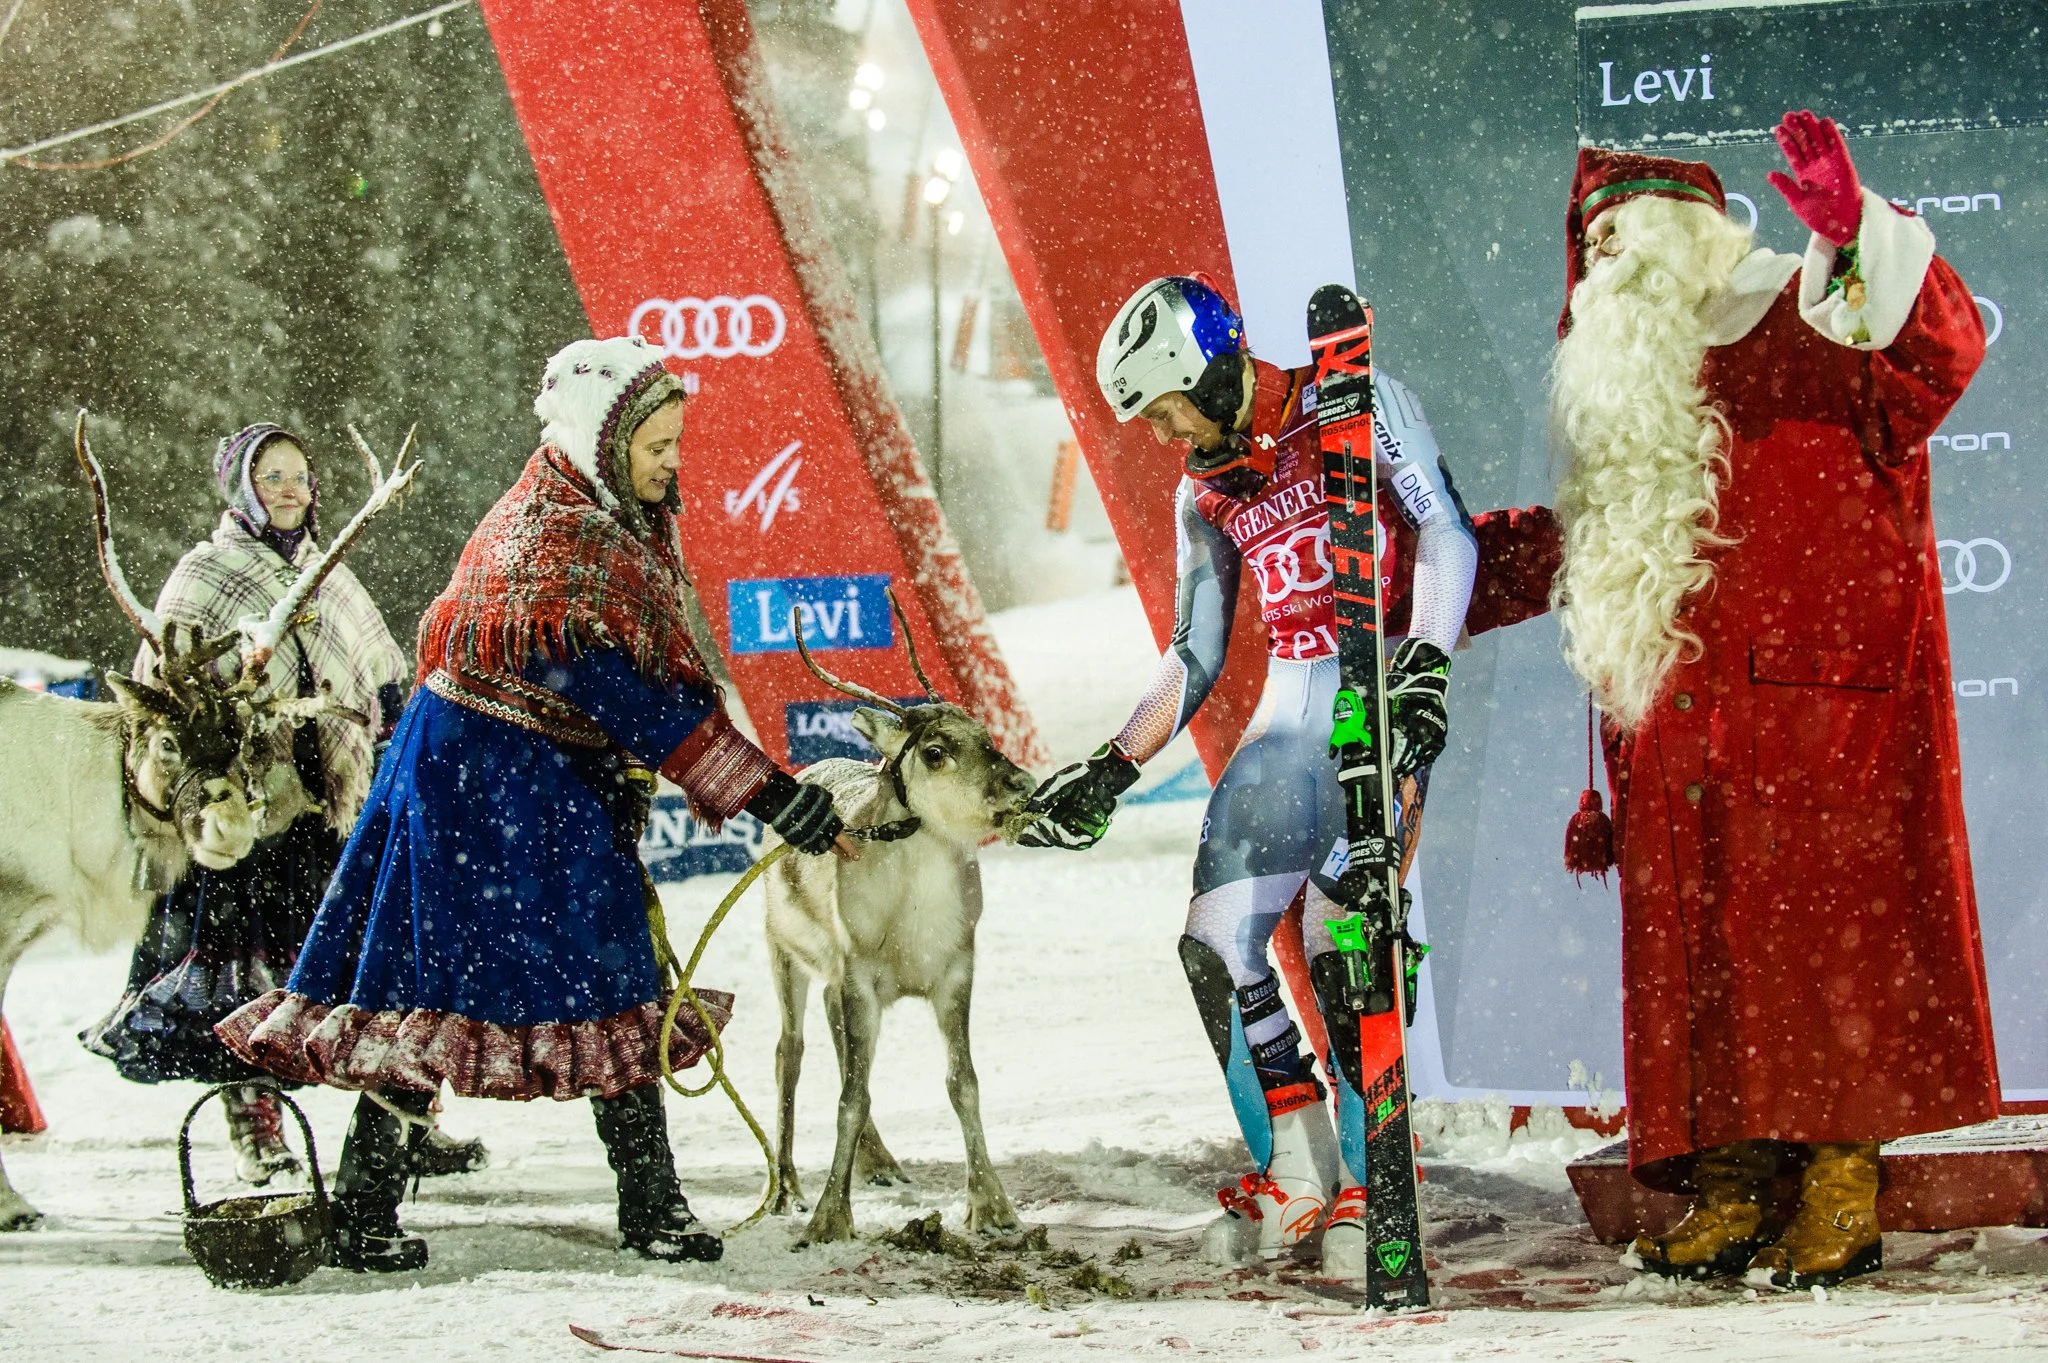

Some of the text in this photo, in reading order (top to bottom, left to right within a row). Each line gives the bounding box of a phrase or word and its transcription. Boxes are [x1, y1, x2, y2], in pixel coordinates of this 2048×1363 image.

[1599, 54, 1715, 106] Levi
[1892, 193, 2001, 215] tron
[1317, 404, 1346, 419] HEROES
[1374, 405, 1402, 461] enix
[1927, 432, 2010, 452] ron
[1400, 473, 1435, 514] DNB
[755, 583, 864, 642] Levi
[1282, 600, 1302, 617] Ski
[1304, 594, 1332, 609] Wo
[1952, 677, 2018, 697] on
[1349, 848, 1370, 859] EROES
[1376, 1096, 1396, 1124] SL
